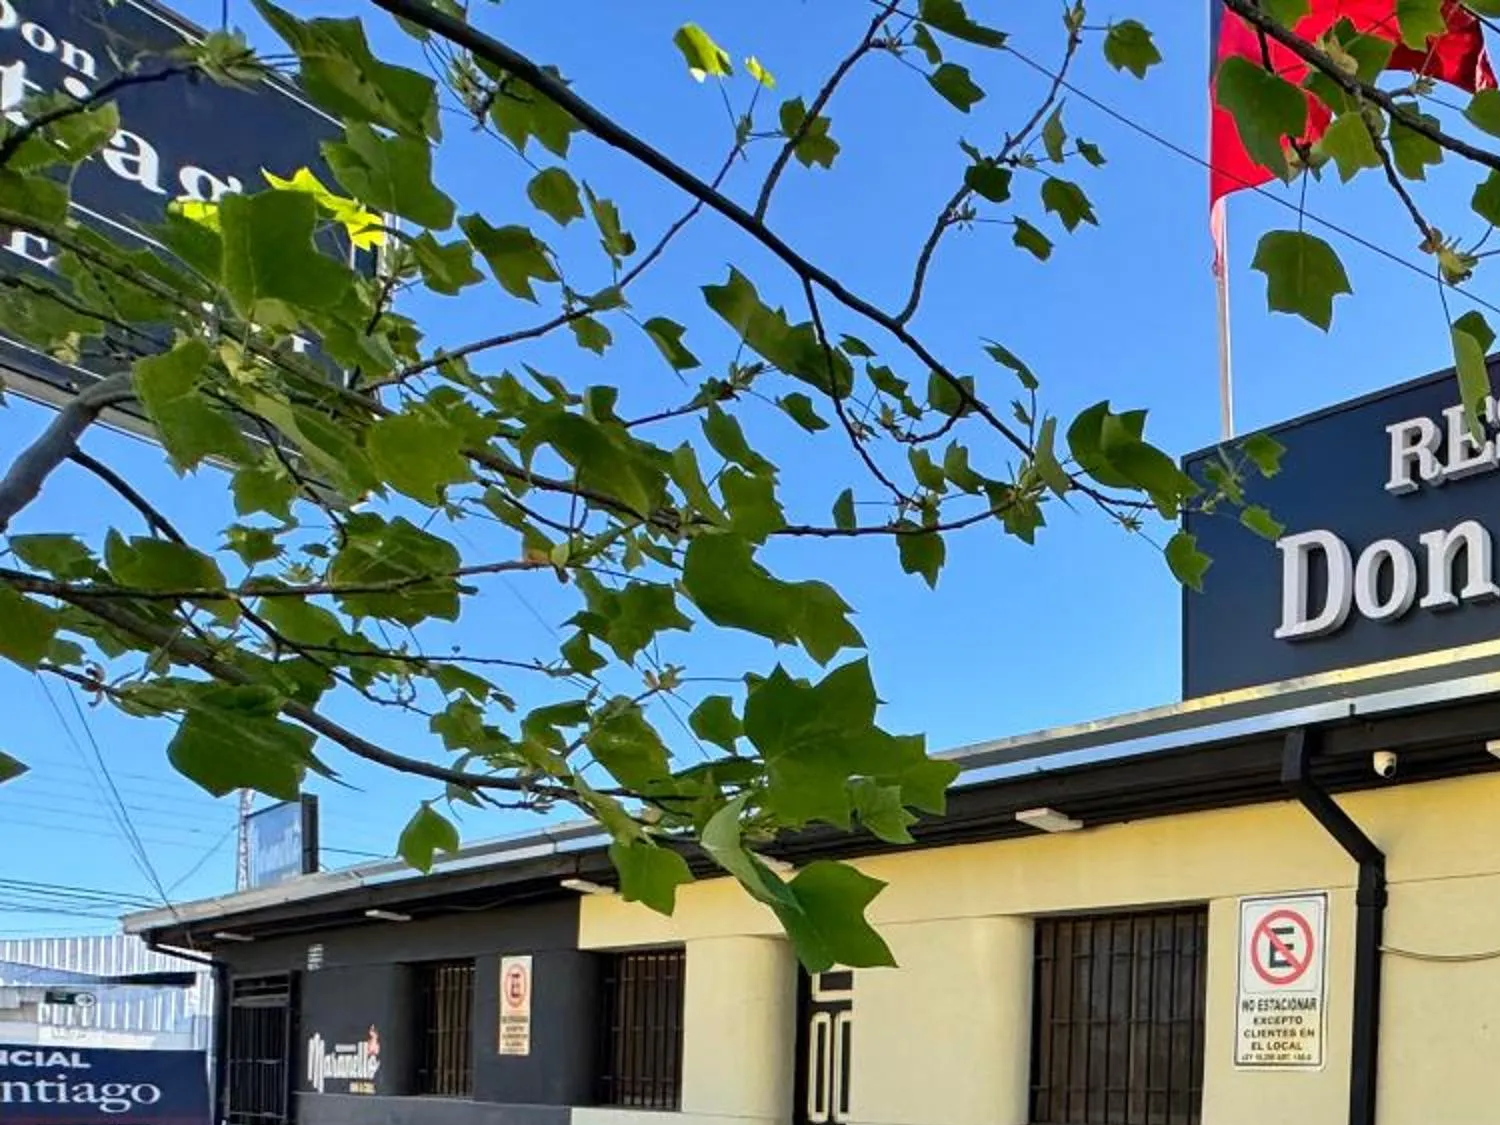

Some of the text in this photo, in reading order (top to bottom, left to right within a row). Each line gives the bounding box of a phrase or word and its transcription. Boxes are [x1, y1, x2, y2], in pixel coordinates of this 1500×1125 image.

[1272, 517, 1500, 639] Don
[1241, 997, 1317, 1012] NO ESTACIONAR
[1253, 1015, 1303, 1025] EXCEPTO
[1243, 1028, 1315, 1039] CLIENTES EN
[1251, 1041, 1303, 1051] EL LOCAL
[0, 1073, 161, 1113] ntiago
